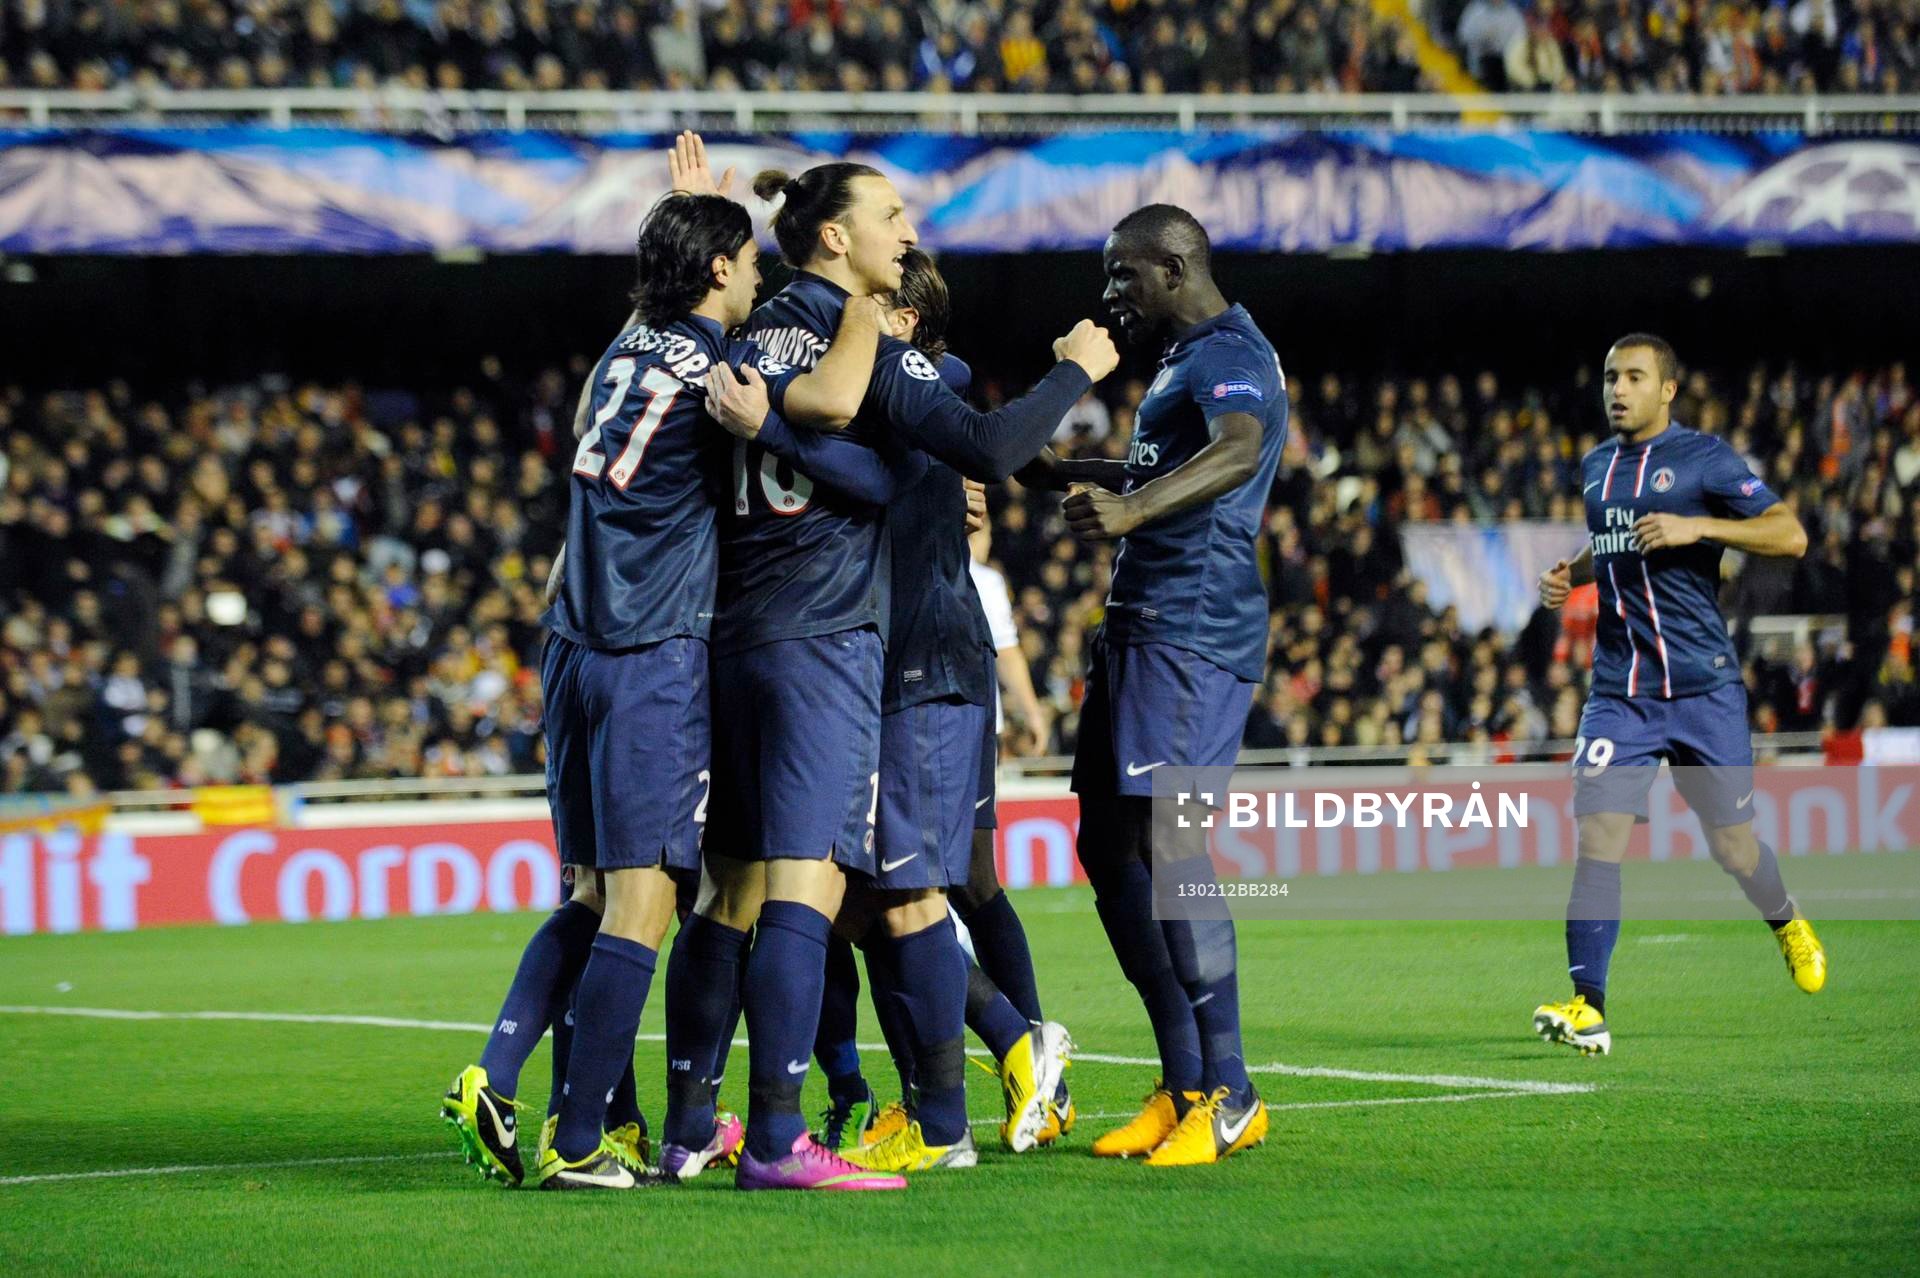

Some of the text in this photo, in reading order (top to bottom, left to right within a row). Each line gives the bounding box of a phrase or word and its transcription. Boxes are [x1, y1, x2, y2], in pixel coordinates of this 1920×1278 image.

[572, 356, 684, 491] 27
[1605, 506, 1634, 529] Fly
[693, 769, 711, 822] 2
[866, 773, 879, 825] 1
[208, 829, 559, 926] Corpo
[498, 1019, 518, 1035] PSG
[671, 1059, 691, 1071] PSG
